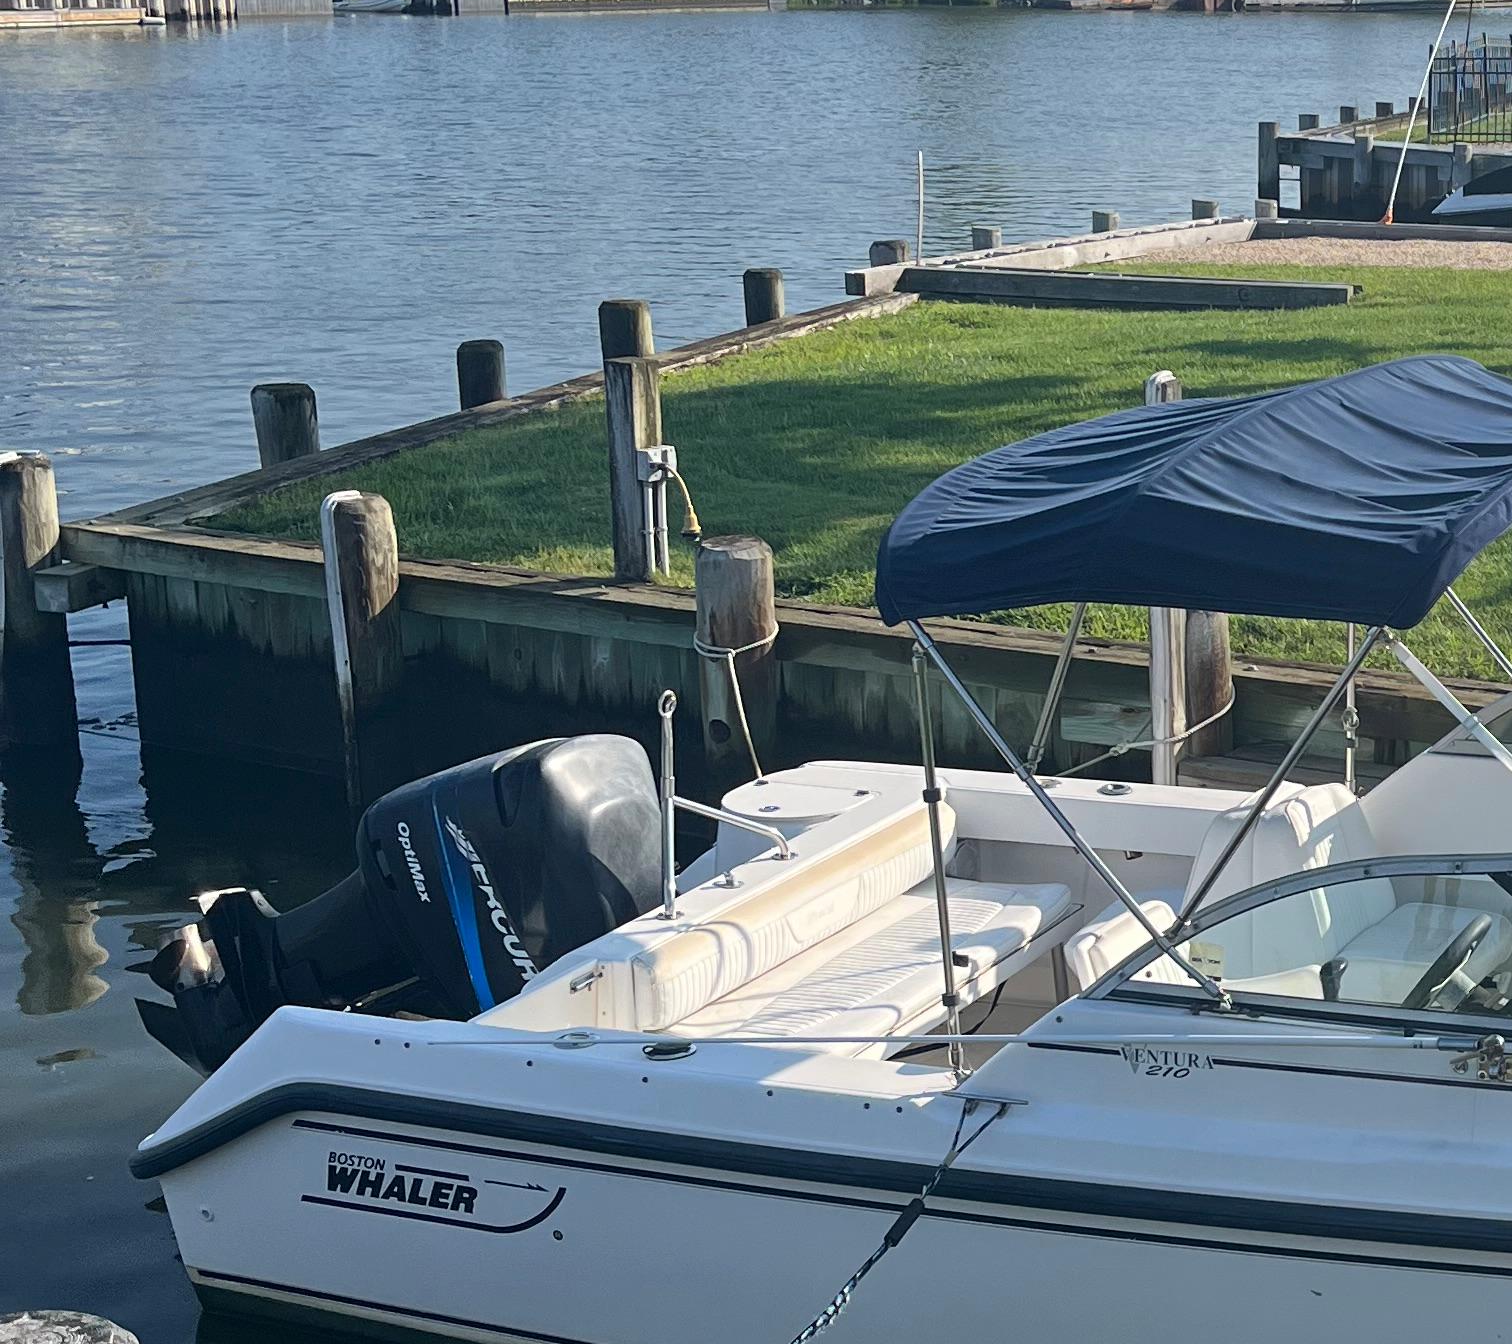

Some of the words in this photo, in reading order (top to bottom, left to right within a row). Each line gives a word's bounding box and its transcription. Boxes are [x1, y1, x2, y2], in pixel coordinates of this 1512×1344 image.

[1120, 1044, 1214, 1072] VENTURA
[1145, 1065, 1190, 1078] 210
[328, 1151, 385, 1170] BOSTON
[327, 1164, 478, 1213] WHALER
